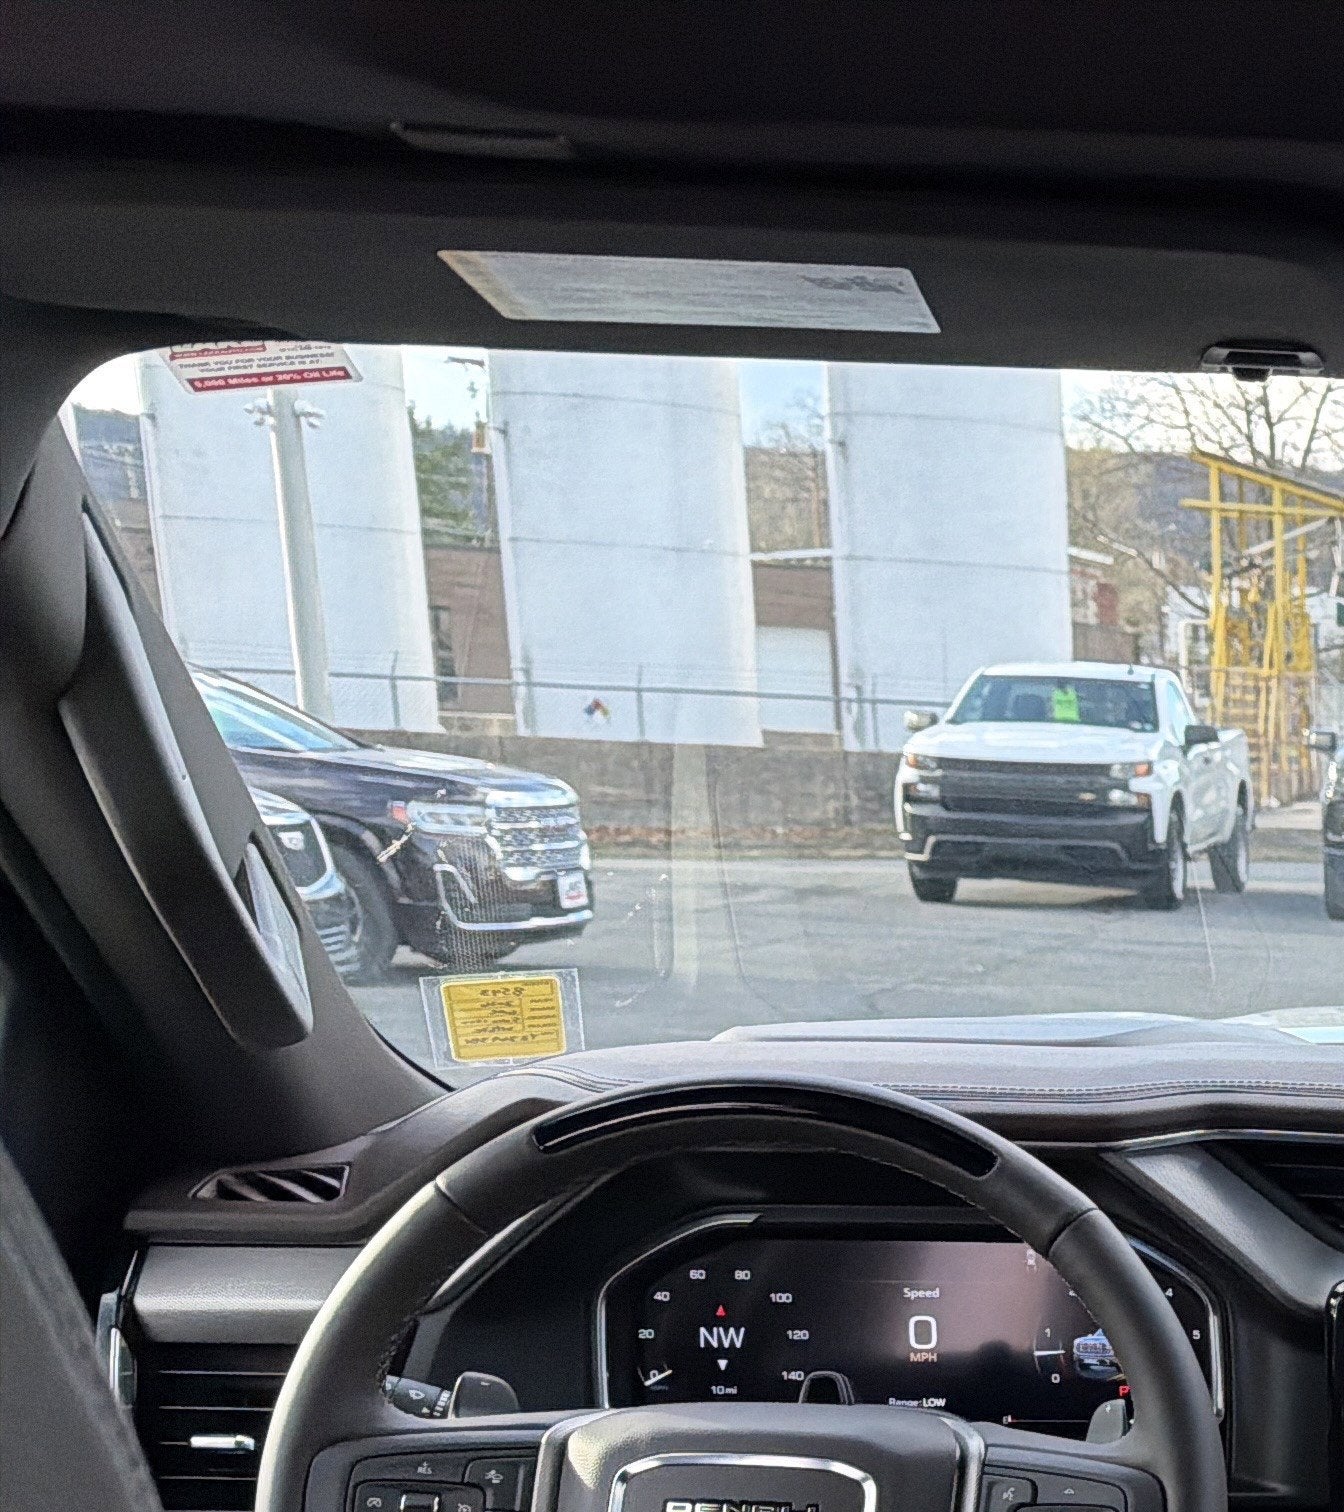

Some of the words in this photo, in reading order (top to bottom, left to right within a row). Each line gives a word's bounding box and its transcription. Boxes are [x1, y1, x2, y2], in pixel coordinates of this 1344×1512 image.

[689, 1269, 706, 1280] 60
[734, 1270, 751, 1280] 80
[654, 1291, 671, 1302] 40
[769, 1293, 793, 1303] 100
[903, 1287, 940, 1300] Speed
[1165, 1287, 1174, 1298] 4
[638, 1329, 655, 1339] 20
[699, 1326, 746, 1348] NW
[786, 1330, 810, 1340] 120
[908, 1315, 938, 1350] 0
[1044, 1328, 1051, 1338] 1
[1192, 1330, 1201, 1340] 5
[910, 1352, 938, 1362] MPH
[781, 1370, 805, 1381] 140
[1051, 1374, 1061, 1384] 0
[1118, 1385, 1131, 1396] P
[922, 1397, 946, 1408] LOW
